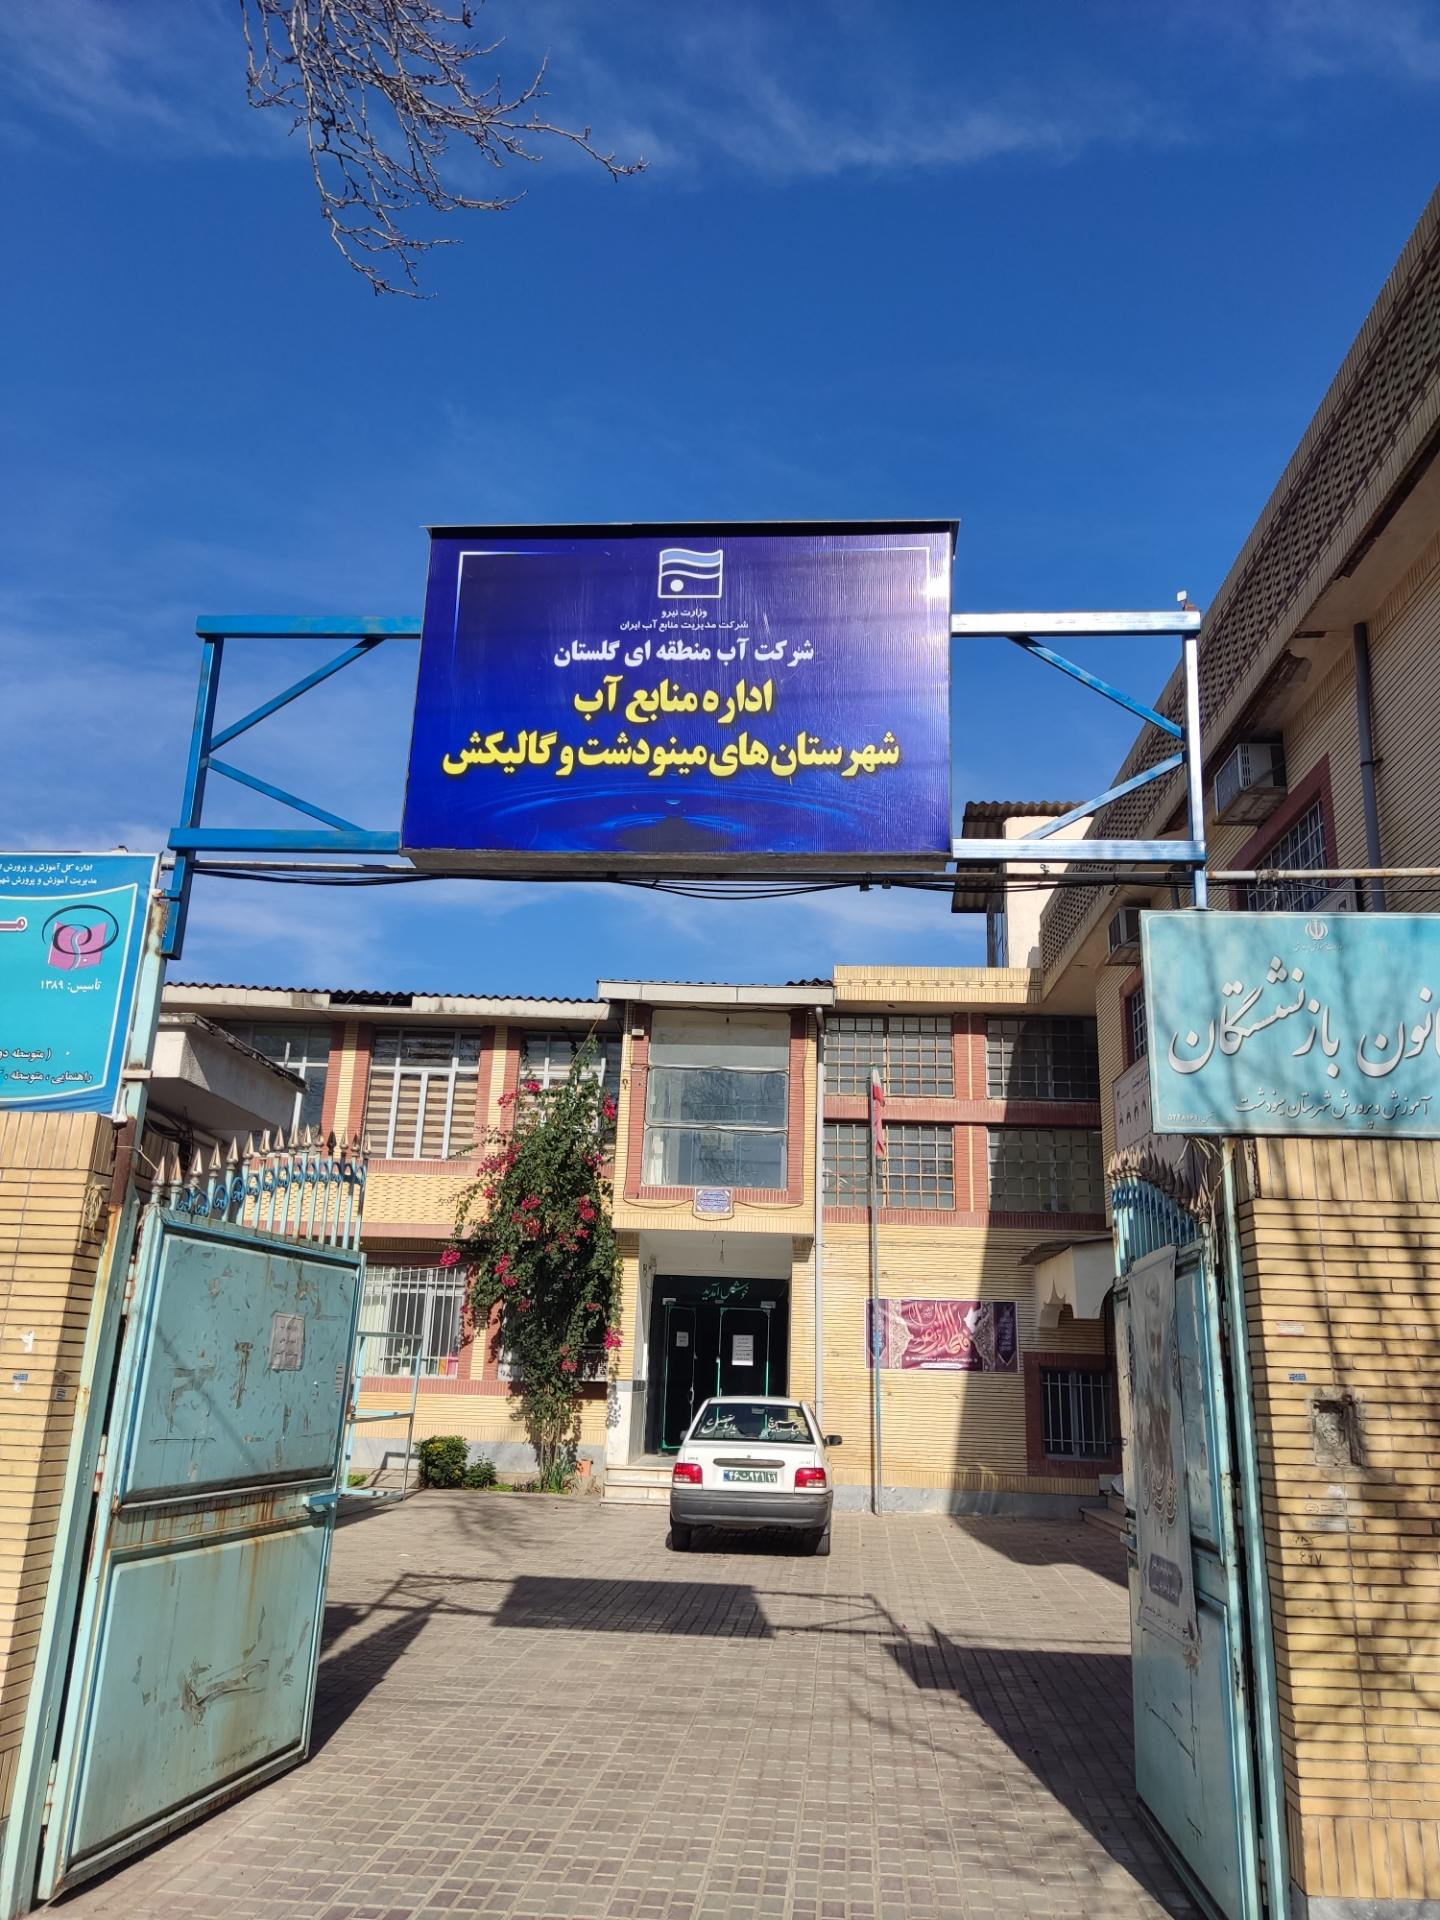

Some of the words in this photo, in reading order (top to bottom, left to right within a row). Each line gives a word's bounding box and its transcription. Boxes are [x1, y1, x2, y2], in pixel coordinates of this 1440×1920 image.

[661, 608, 679, 618] نیرو
[680, 608, 708, 619] وزارت
[620, 620, 641, 631] ایران
[641, 619, 658, 631] آب
[658, 621, 679, 633] منابع
[680, 622, 717, 631] مدیریت
[718, 621, 749, 631] شرکت
[553, 639, 621, 668] گلستان
[624, 639, 651, 668] ای
[655, 639, 711, 661] منطقه
[716, 637, 750, 666] آب
[754, 639, 815, 667] شرکت
[574, 674, 624, 722] آب
[625, 677, 699, 723] منابع
[702, 677, 773, 724] اداره
[442, 729, 559, 775] گالیکش
[555, 745, 574, 776] و
[578, 731, 708, 777] مینودشت
[708, 731, 770, 777] های
[771, 730, 900, 777] شهرستان
[3, 863, 27, 873] پرورش
[28, 864, 34, 873] و
[34, 862, 62, 873] آموزش
[61, 863, 75, 874] کل
[75, 864, 94, 873] اداره
[11, 876, 36, 886] پرورش
[36, 877, 42, 886] و
[42, 876, 68, 886] آموزش
[69, 877, 98, 887] مدیریت
[41, 980, 64, 990] ۱۳۸۹
[1166, 955, 1341, 1079] بازنشستگان
[1233, 1087, 1287, 1116] مینودشت
[1287, 1089, 1332, 1119] شهرستان
[1331, 1089, 1375, 1129] پرورش
[1374, 1103, 1381, 1115] و
[1381, 1089, 1433, 1120] آموزش
